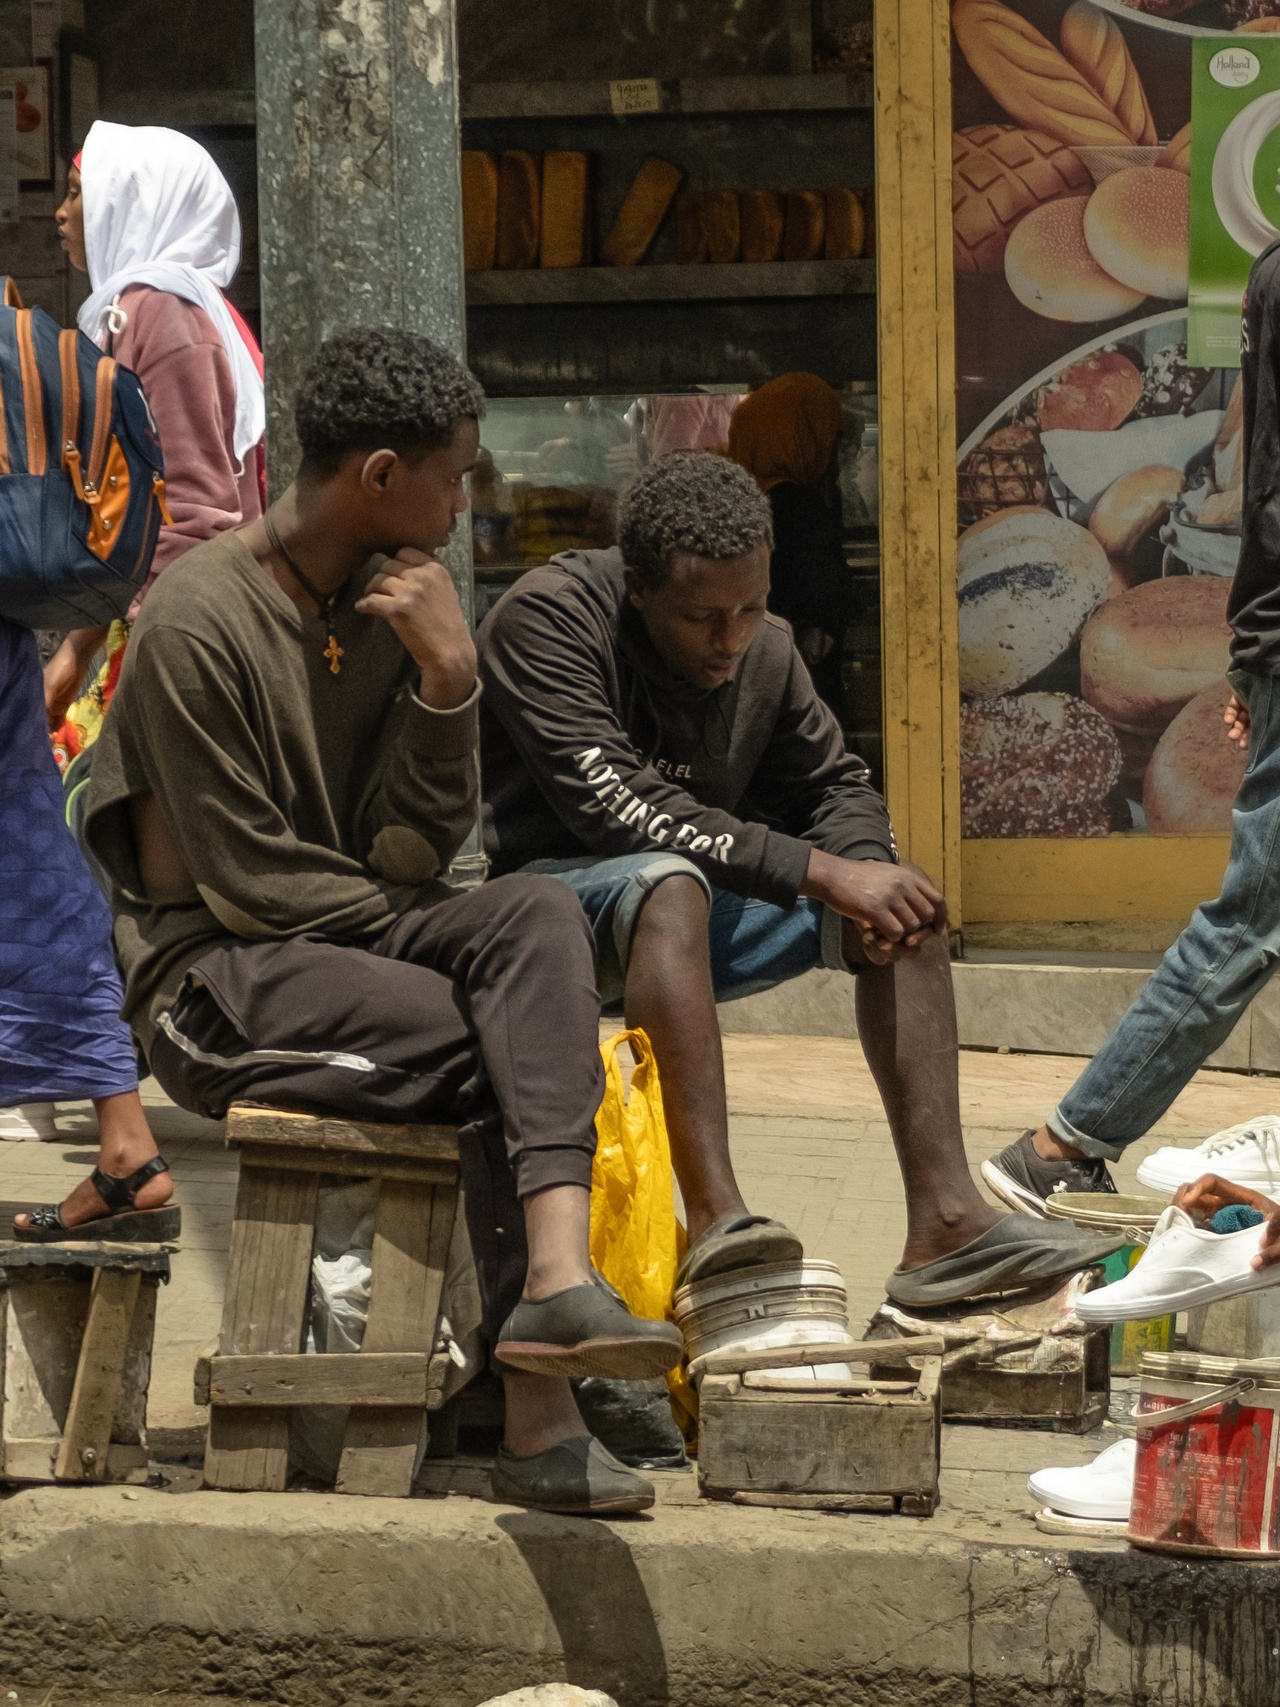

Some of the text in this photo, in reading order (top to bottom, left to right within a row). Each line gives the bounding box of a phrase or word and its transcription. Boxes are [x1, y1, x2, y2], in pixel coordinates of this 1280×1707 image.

[1216, 54, 1251, 71] Holland
[573, 747, 735, 864] NOTHING FOR
